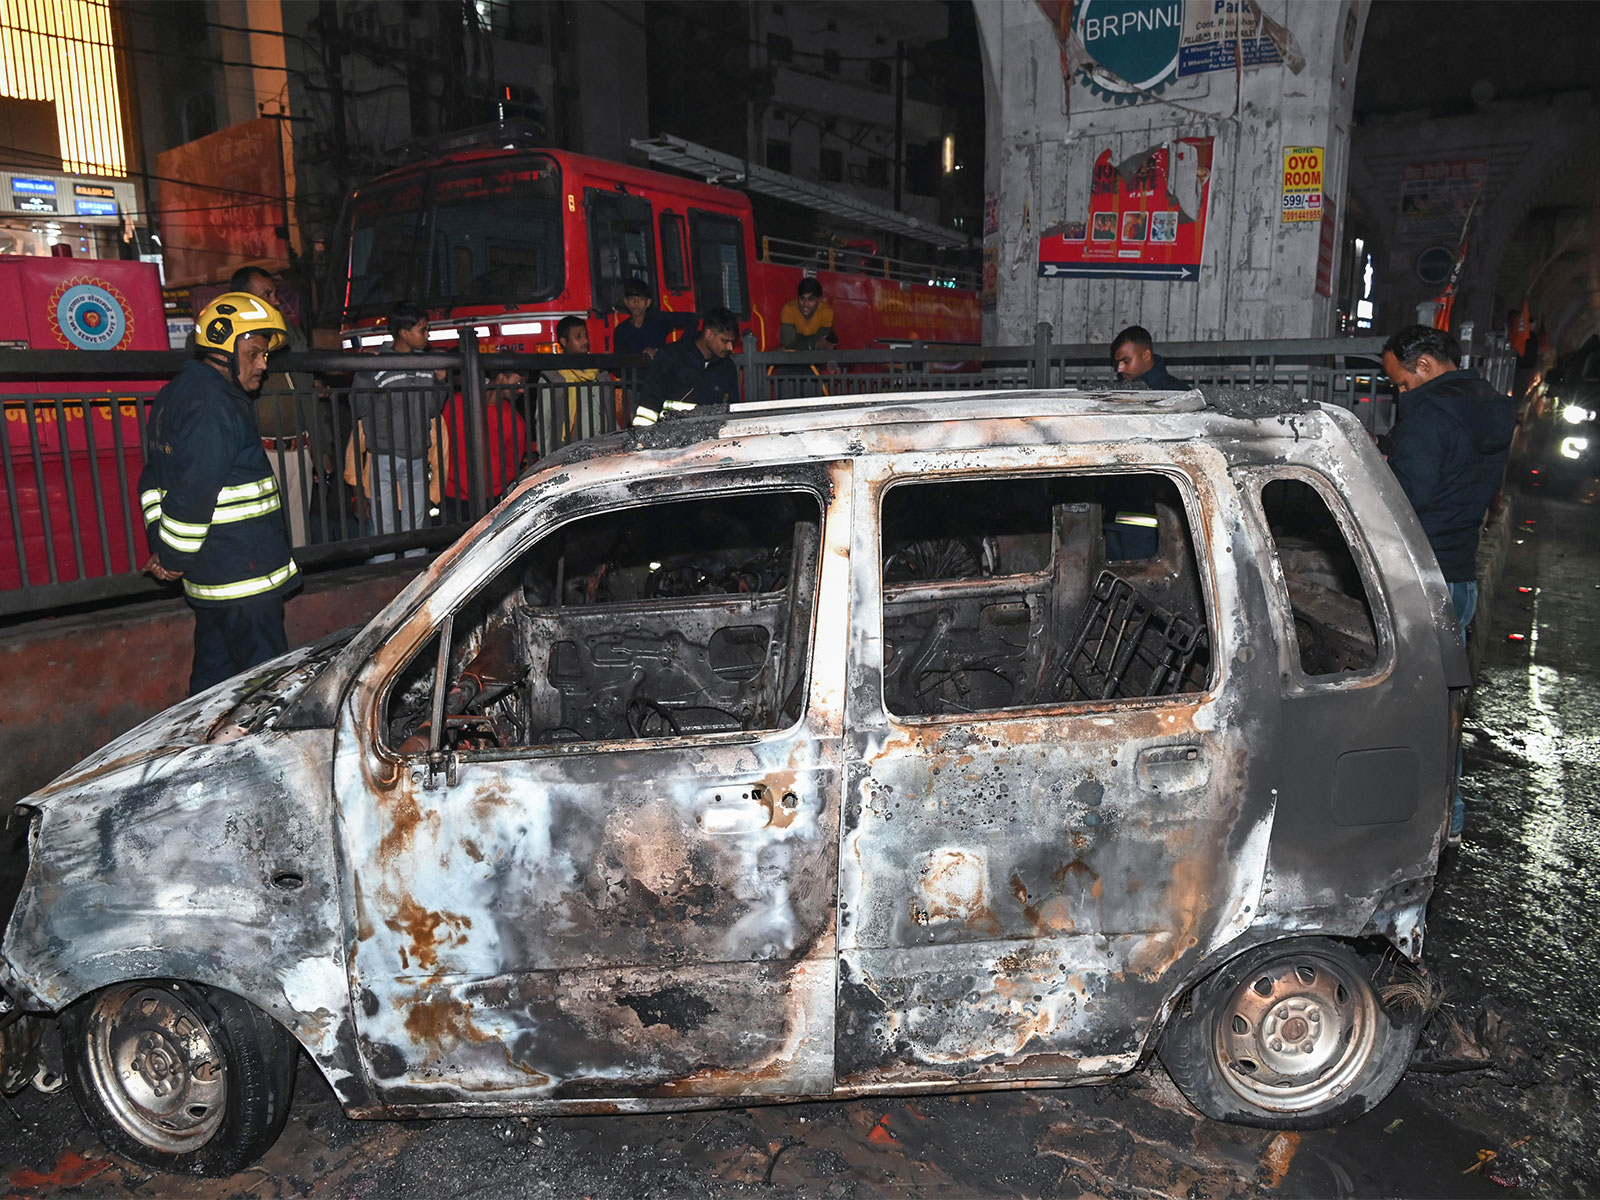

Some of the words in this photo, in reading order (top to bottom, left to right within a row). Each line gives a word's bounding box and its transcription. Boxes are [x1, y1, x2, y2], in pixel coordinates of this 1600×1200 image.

[1086, 4, 1181, 41] BRPNNL
[1288, 155, 1319, 170] OYO
[1284, 171, 1321, 188] ROOM
[1283, 194, 1309, 206] 599/-
[78, 331, 98, 343] SERVE
[106, 321, 116, 338] SAVE
